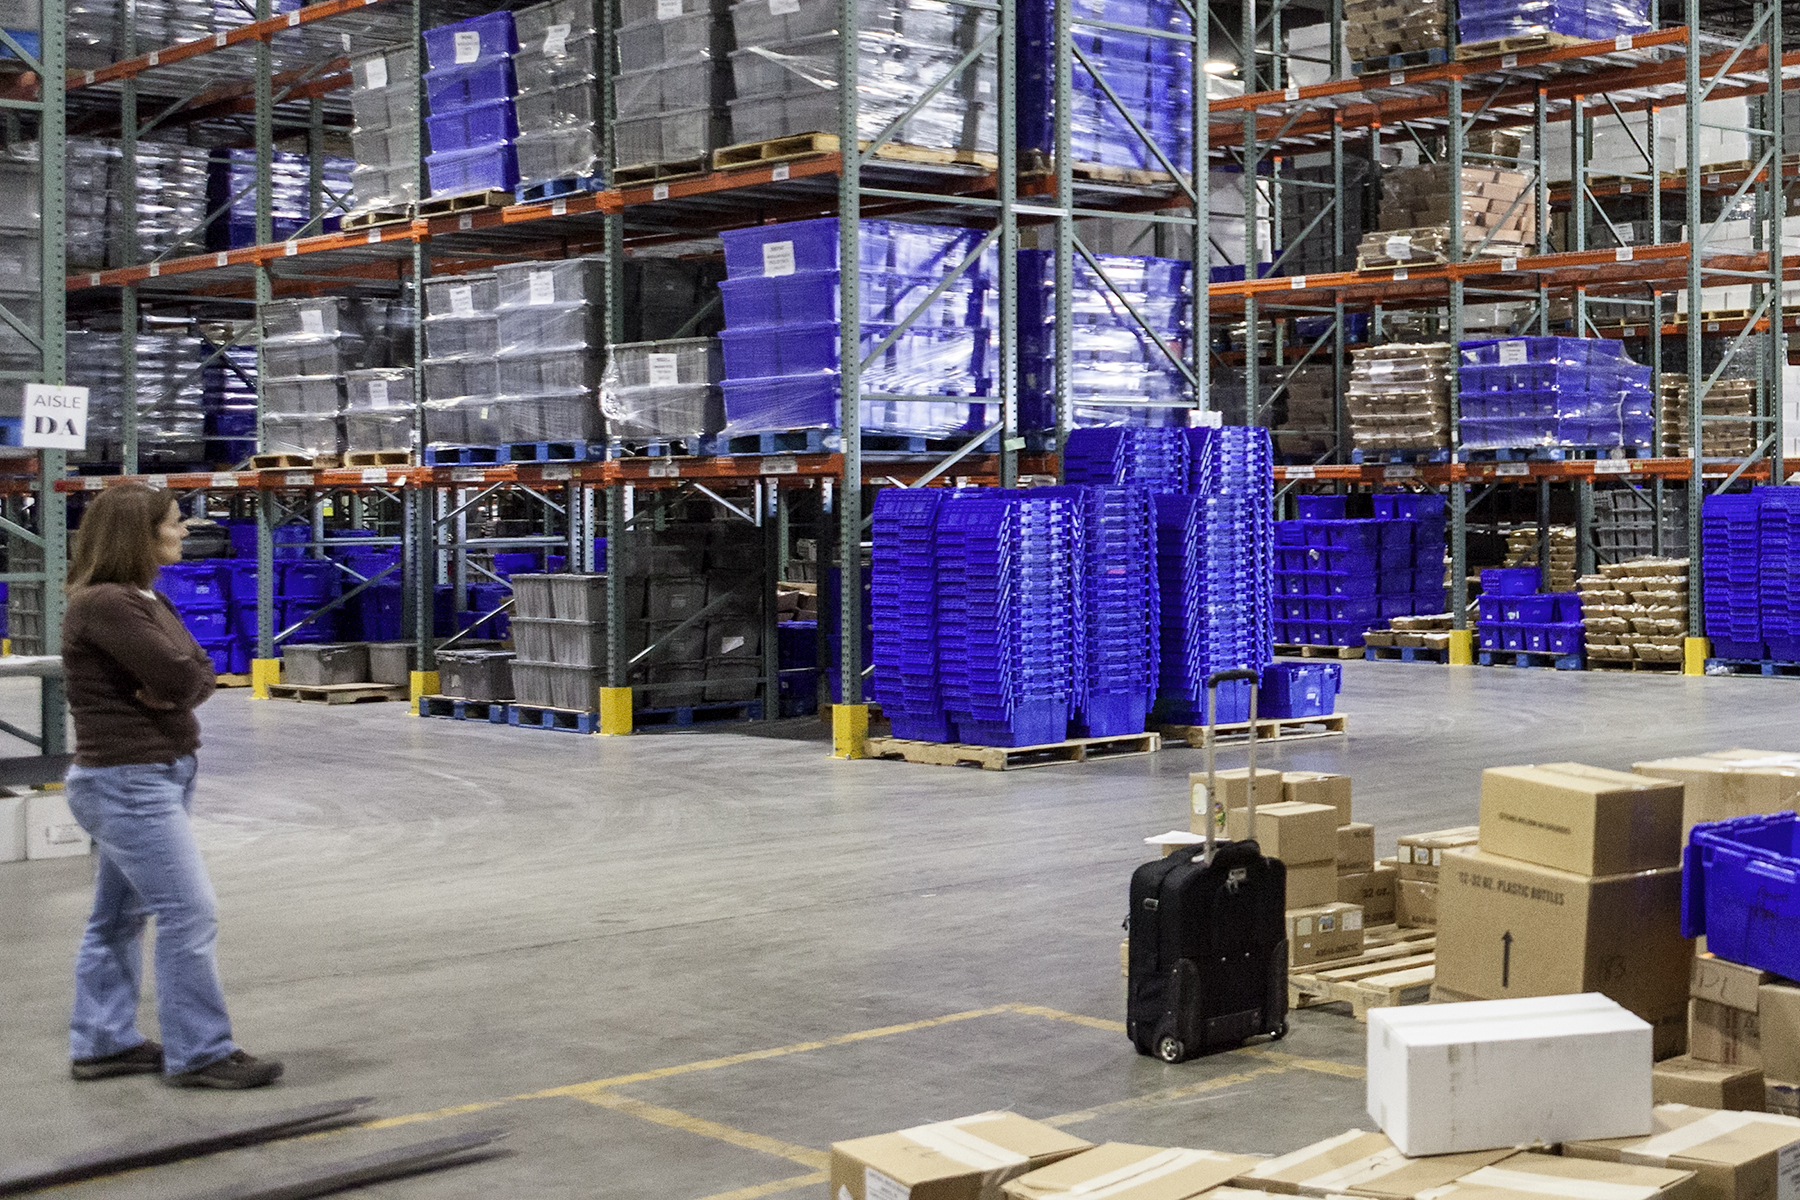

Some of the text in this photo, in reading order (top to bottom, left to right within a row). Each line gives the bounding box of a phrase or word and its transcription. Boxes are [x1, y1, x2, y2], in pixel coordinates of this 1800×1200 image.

[33, 395, 82, 409] AISLE
[34, 415, 80, 436] DA
[1362, 888, 1374, 899] 32
[1497, 879, 1530, 899] PLASTIC
[1530, 887, 1565, 906] BOTTLES
